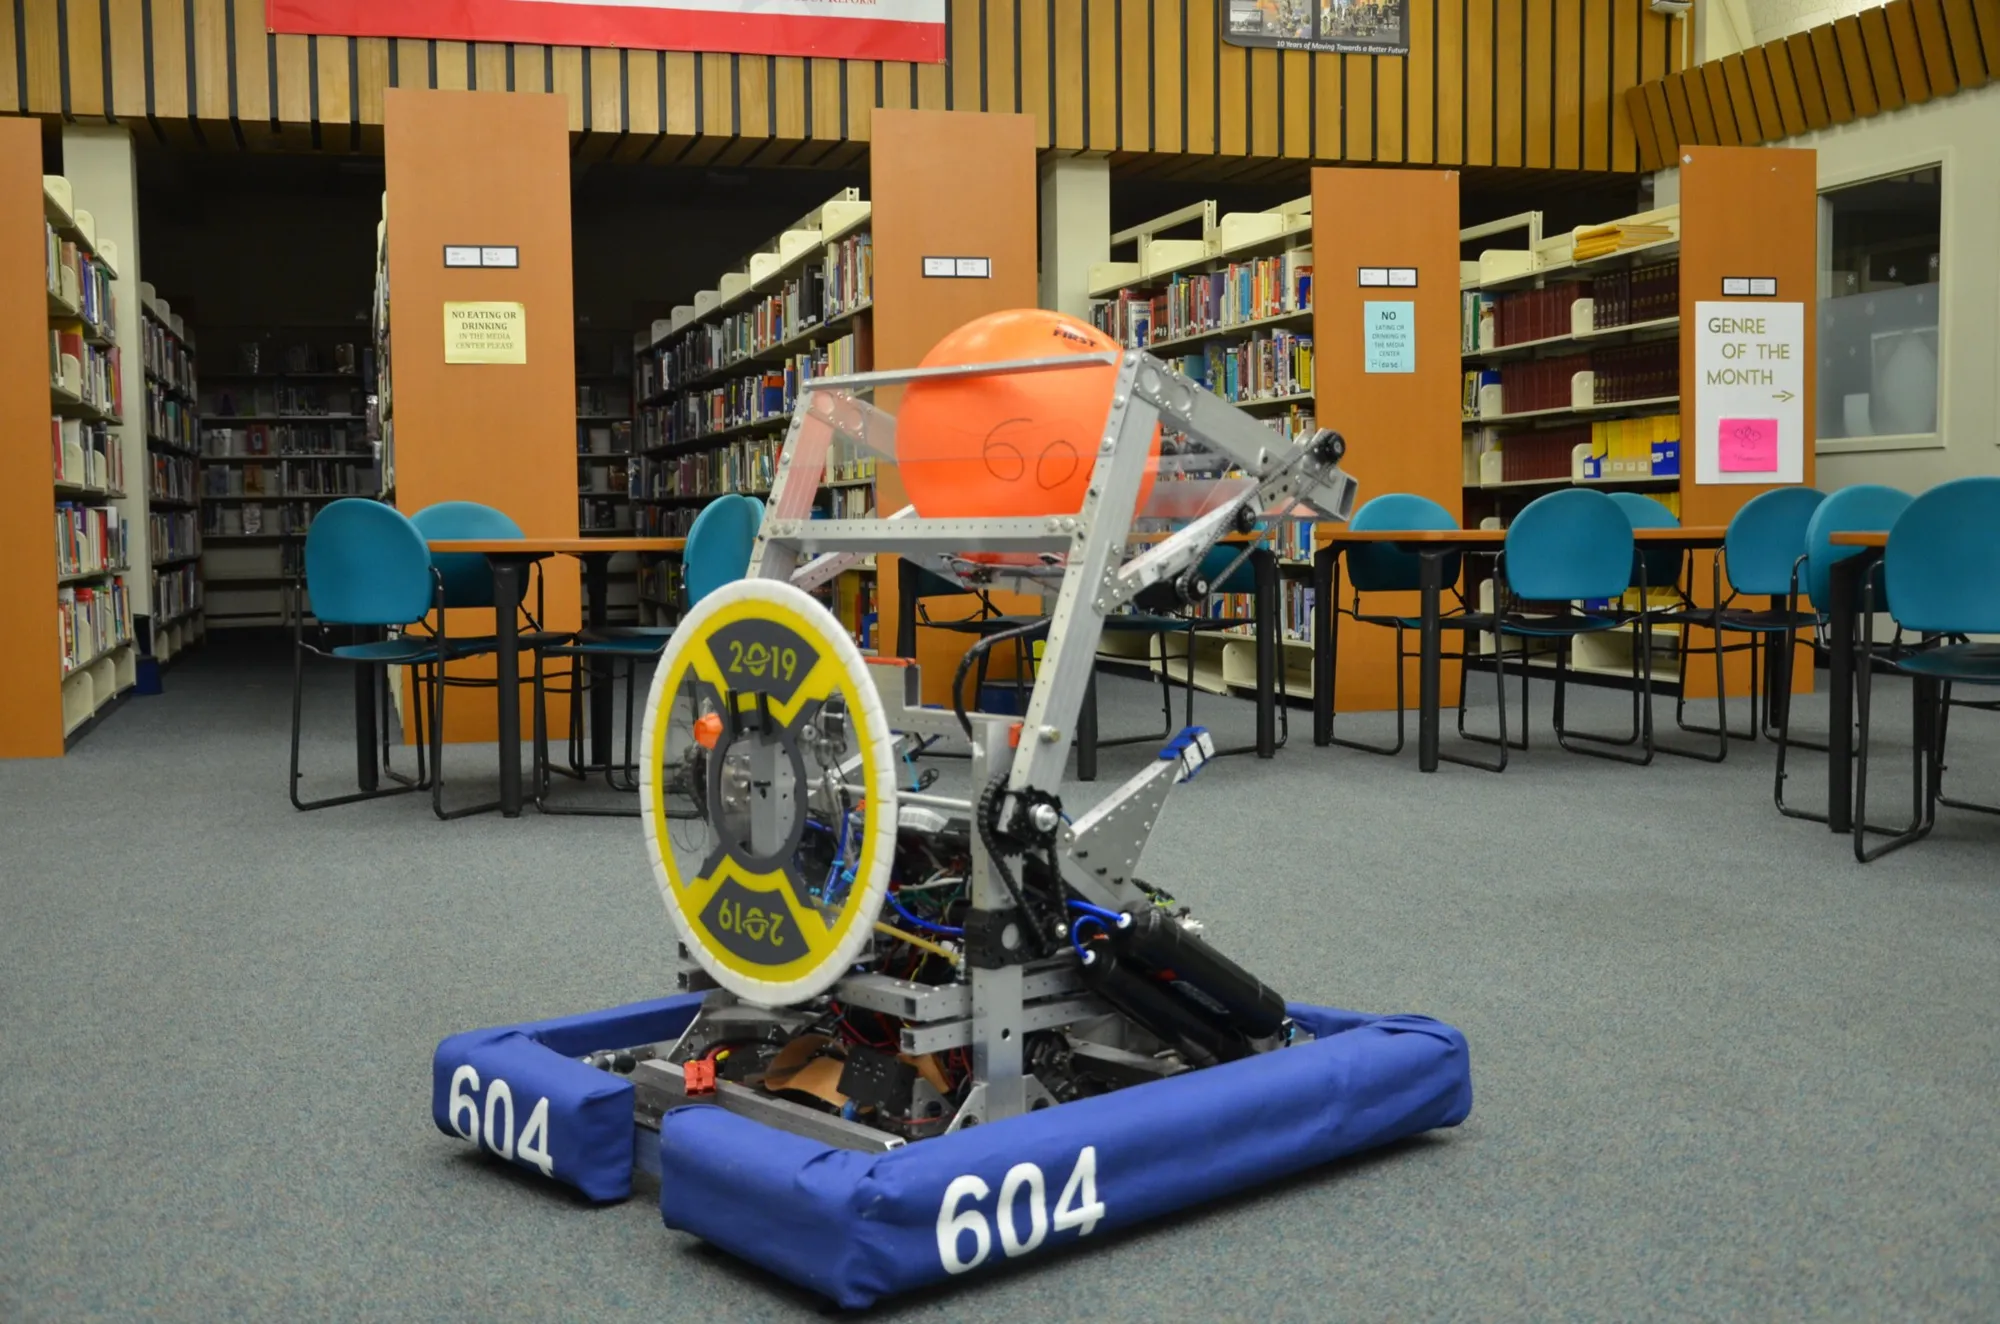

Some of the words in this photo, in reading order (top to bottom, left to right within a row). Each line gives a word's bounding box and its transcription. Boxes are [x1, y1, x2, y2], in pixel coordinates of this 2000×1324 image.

[1304, 42, 1310, 50] of
[1311, 42, 1335, 52] Moving
[1336, 43, 1361, 52] Towards
[1368, 45, 1387, 53] Better
[451, 310, 465, 319] NO
[467, 311, 501, 319] EATING
[503, 311, 517, 319] OR
[1381, 311, 1397, 321] NO
[461, 322, 508, 330] DRINKING
[1708, 317, 1766, 334] GENRE
[459, 332, 467, 340] IN
[469, 332, 485, 340] THE
[486, 332, 511, 340] MEDIA
[1053, 329, 1096, 347] FIRST
[455, 342, 486, 350] CENTER
[487, 342, 514, 350] PLEASE
[1721, 342, 1747, 360] OF
[1756, 343, 1790, 360] THE
[1706, 368, 1773, 386] MONTH
[983, 418, 1097, 491] 60
[728, 639, 797, 683] 2019
[717, 898, 785, 948] 2019
[449, 1064, 554, 1178] 604
[936, 1145, 1105, 1275] 604
